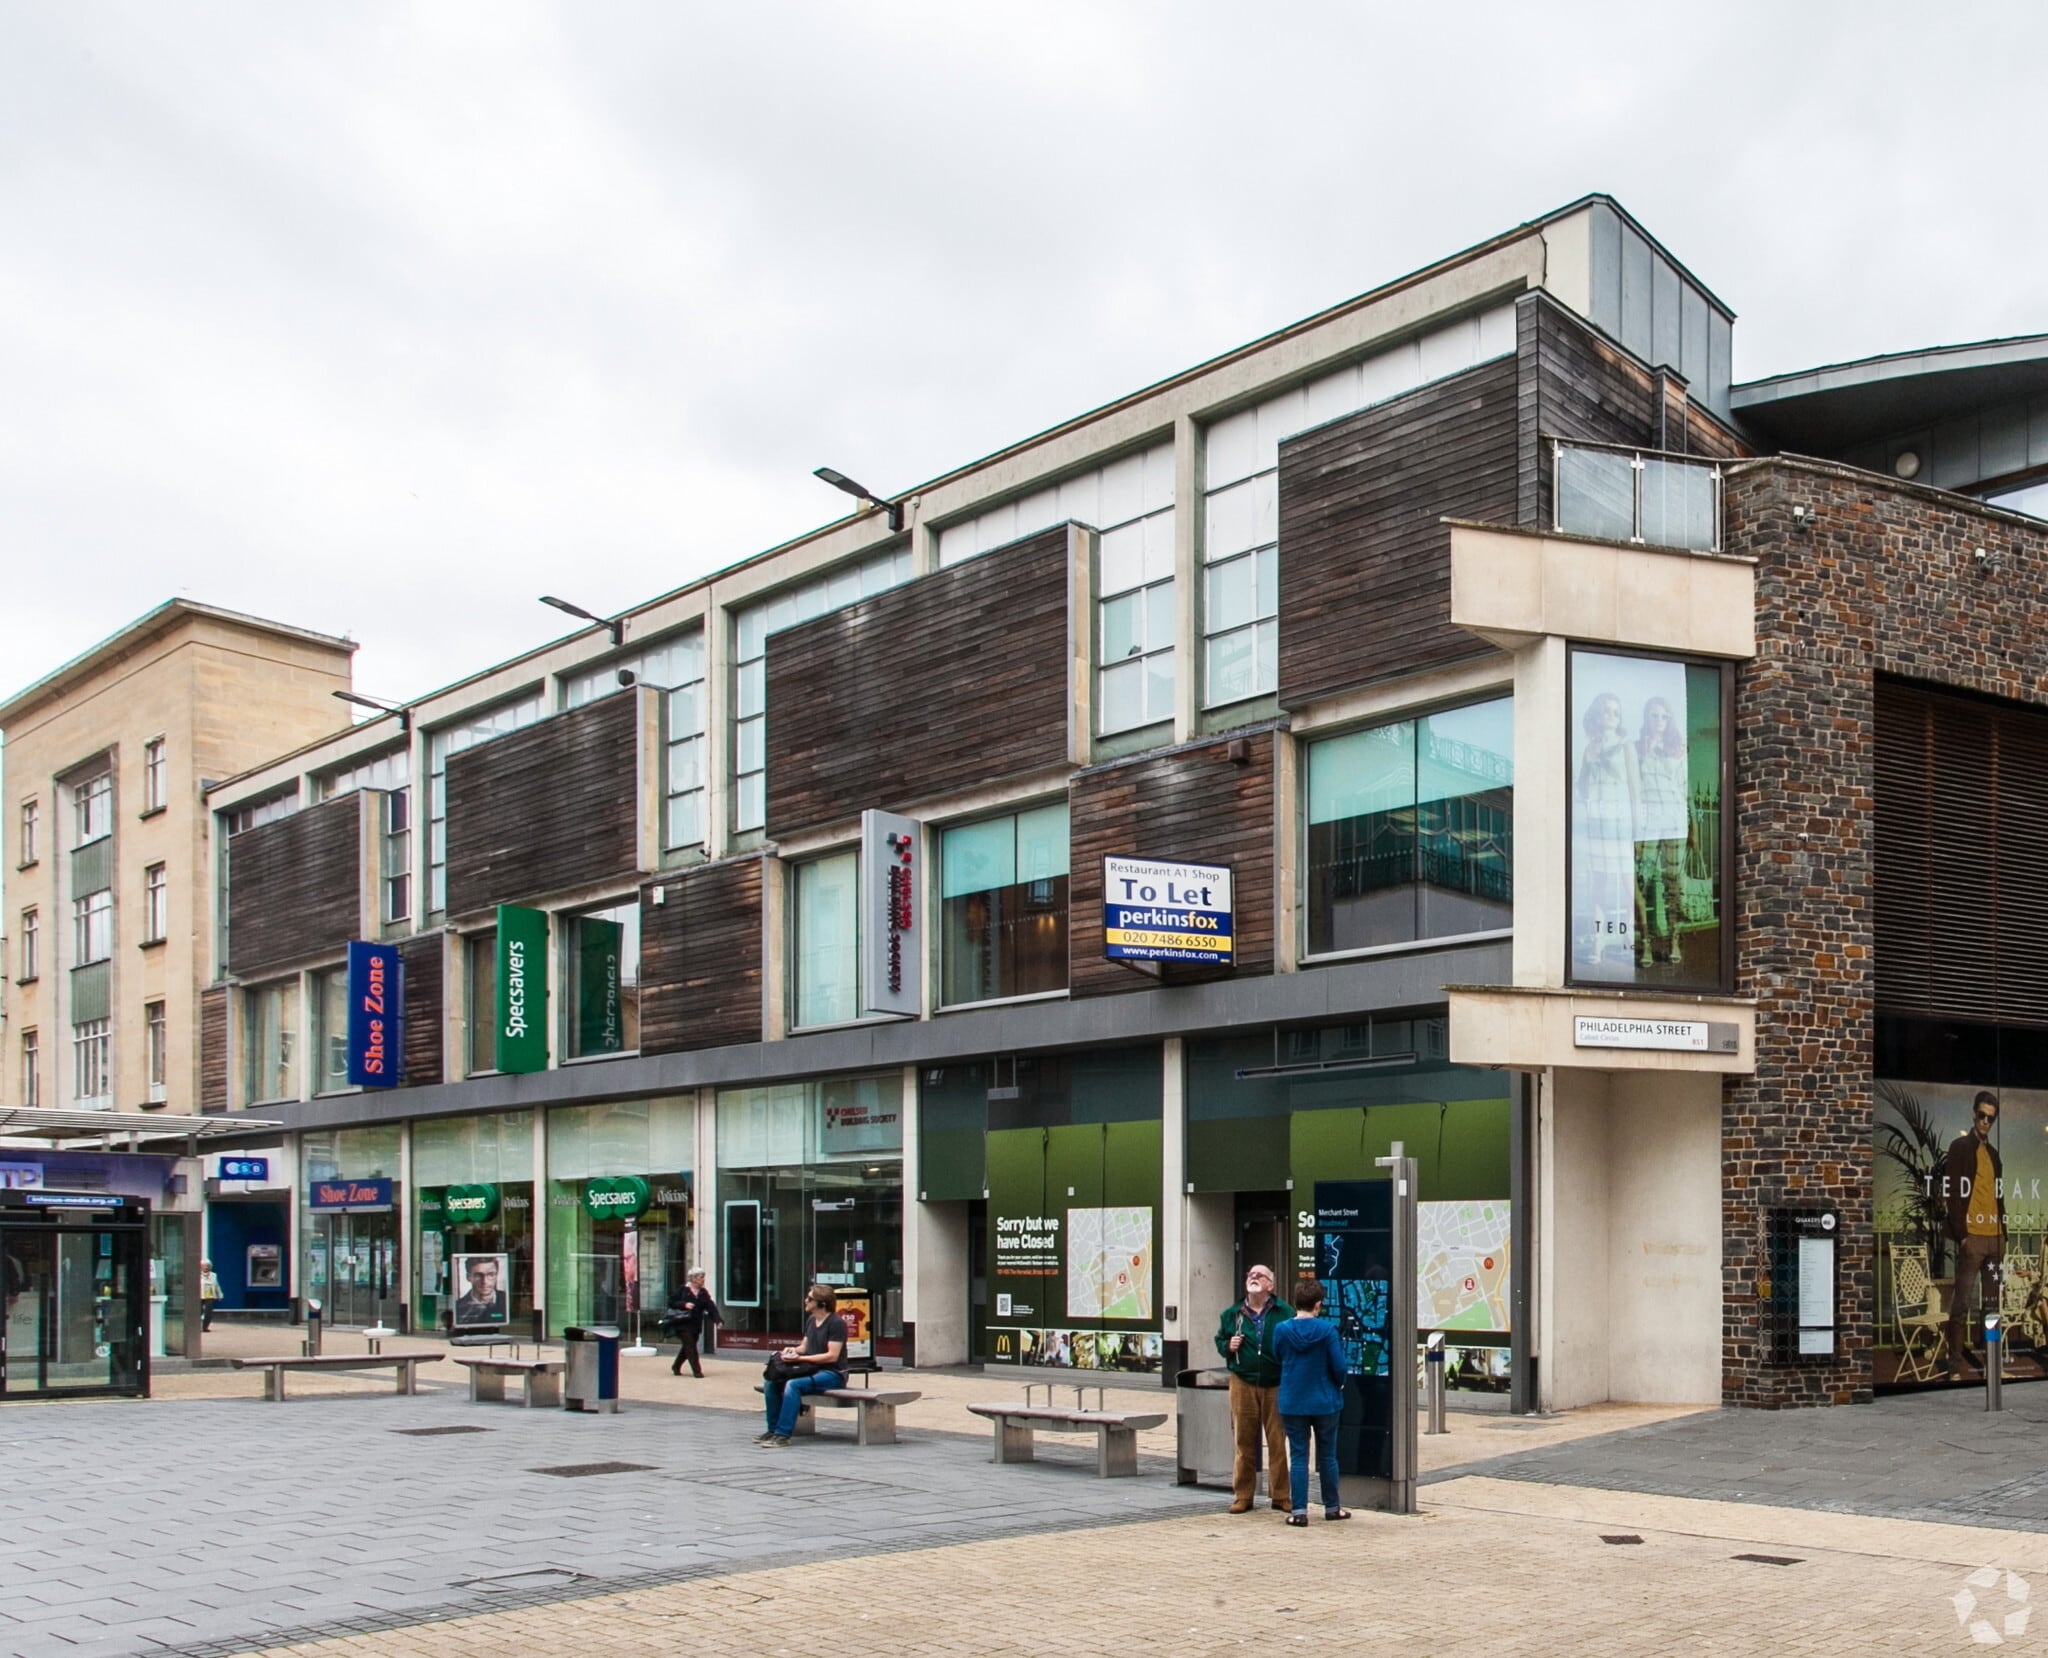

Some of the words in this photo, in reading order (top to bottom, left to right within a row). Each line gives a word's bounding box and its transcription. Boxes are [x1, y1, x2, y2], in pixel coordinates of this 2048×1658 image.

[1110, 863, 1171, 877] Restaurant
[1192, 870, 1220, 883] Shop
[1119, 878, 1157, 901] To
[1167, 882, 1212, 906] Let
[1119, 909, 1218, 930] perkinsfox
[1595, 920, 1627, 934] TED
[1123, 931, 1148, 944] 020
[1151, 933, 1183, 946] 7486
[1185, 936, 1217, 948] 6550
[1122, 946, 1218, 960] www.perkinsfox.com
[364, 956, 384, 1015] Zone
[505, 940, 528, 1039] Specsavers
[1580, 1021, 1654, 1035] PHILADELPHIA
[1656, 1024, 1692, 1036] STREET
[364, 1019, 384, 1074] Shoe
[319, 1184, 347, 1203] Shoe
[349, 1183, 379, 1202] Zone
[1924, 1175, 1972, 1198] TED
[447, 1195, 486, 1212] Specsavers
[588, 1189, 636, 1209] Specsavers
[657, 1189, 688, 1205] Opticians
[1318, 1208, 1342, 1216] Merchant
[1343, 1208, 1359, 1216] Street
[1966, 1213, 2034, 1225] LONDON
[997, 1216, 1025, 1234] Sorry
[1026, 1216, 1042, 1231] but
[1043, 1218, 1059, 1231] we
[997, 1234, 1020, 1249] have
[1021, 1233, 1055, 1249] Closed
